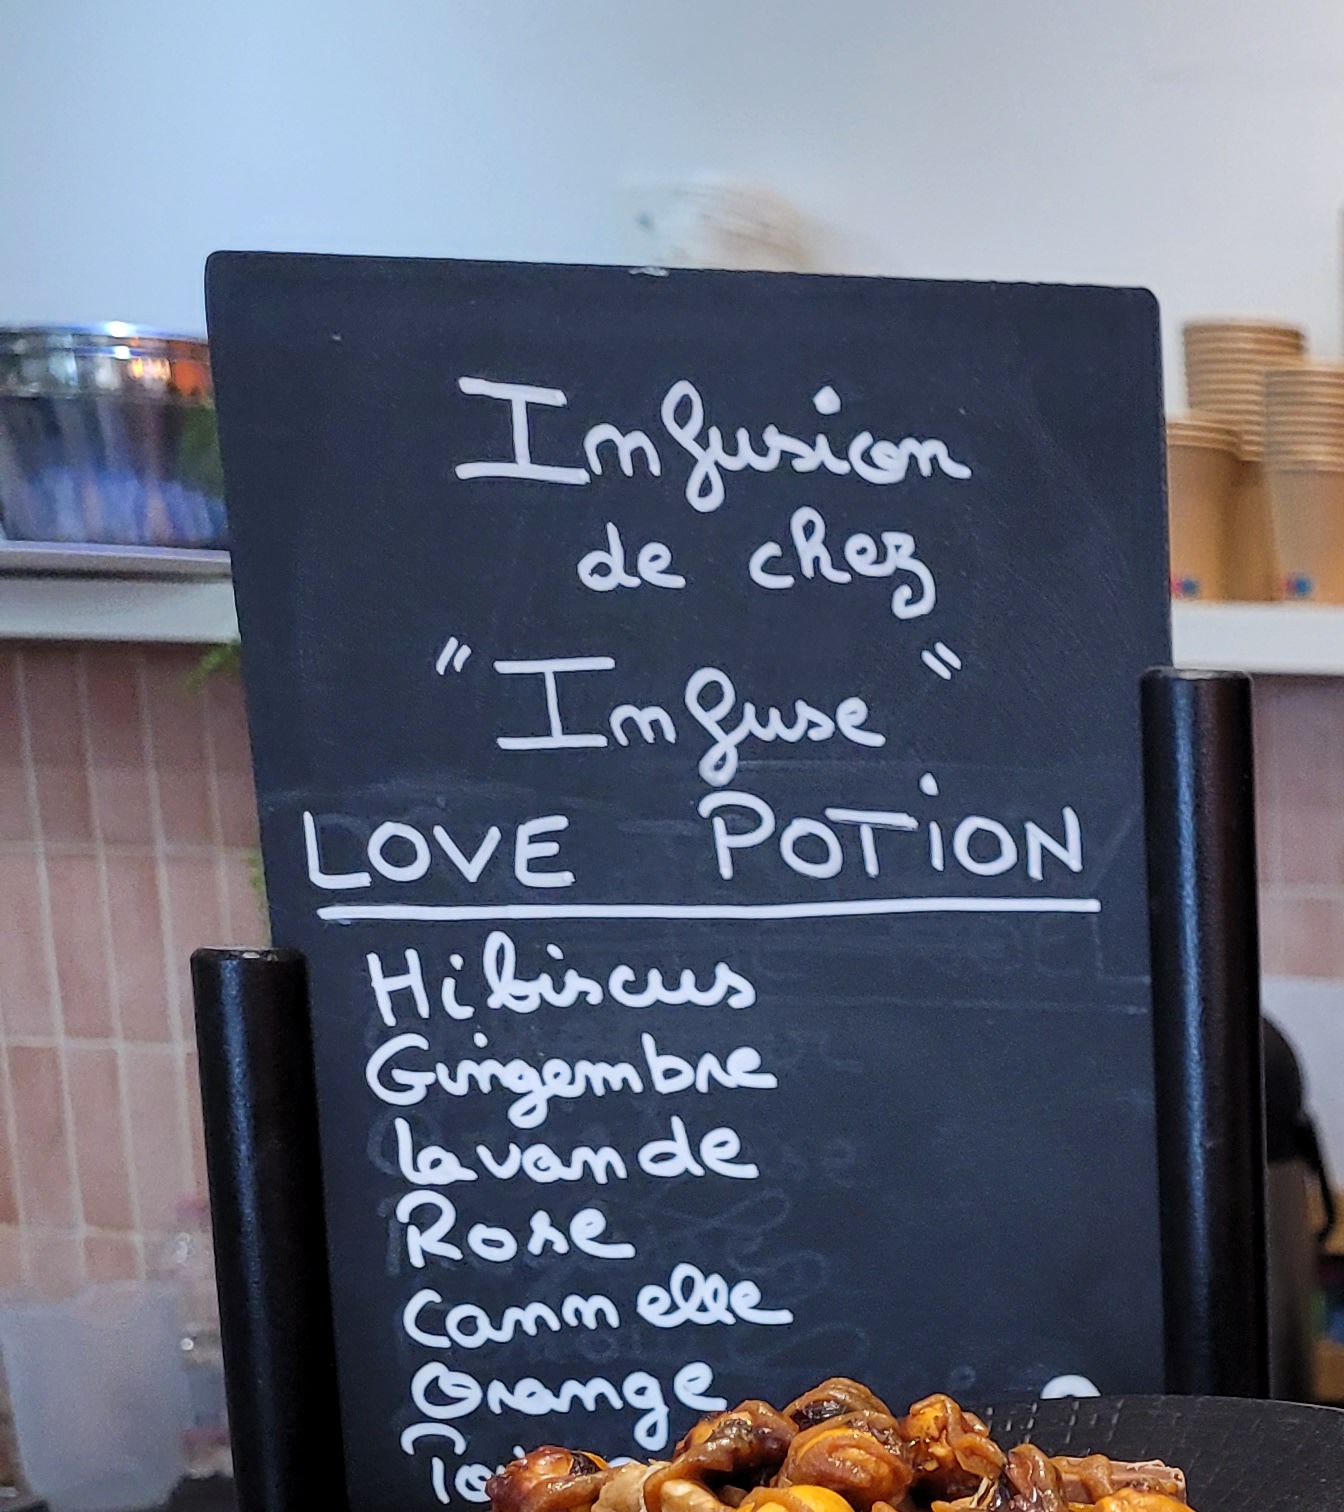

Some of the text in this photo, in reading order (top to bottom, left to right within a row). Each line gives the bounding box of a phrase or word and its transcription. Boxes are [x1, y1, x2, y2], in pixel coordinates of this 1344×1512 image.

[456, 377, 971, 513] Infusion
[578, 507, 935, 618] de chez
[304, 812, 575, 889] LOVE
[367, 932, 755, 1026] Hibiscus
[366, 1033, 777, 1127] Gingembre
[397, 1190, 634, 1267] Rose
[412, 1363, 726, 1451] Orange
